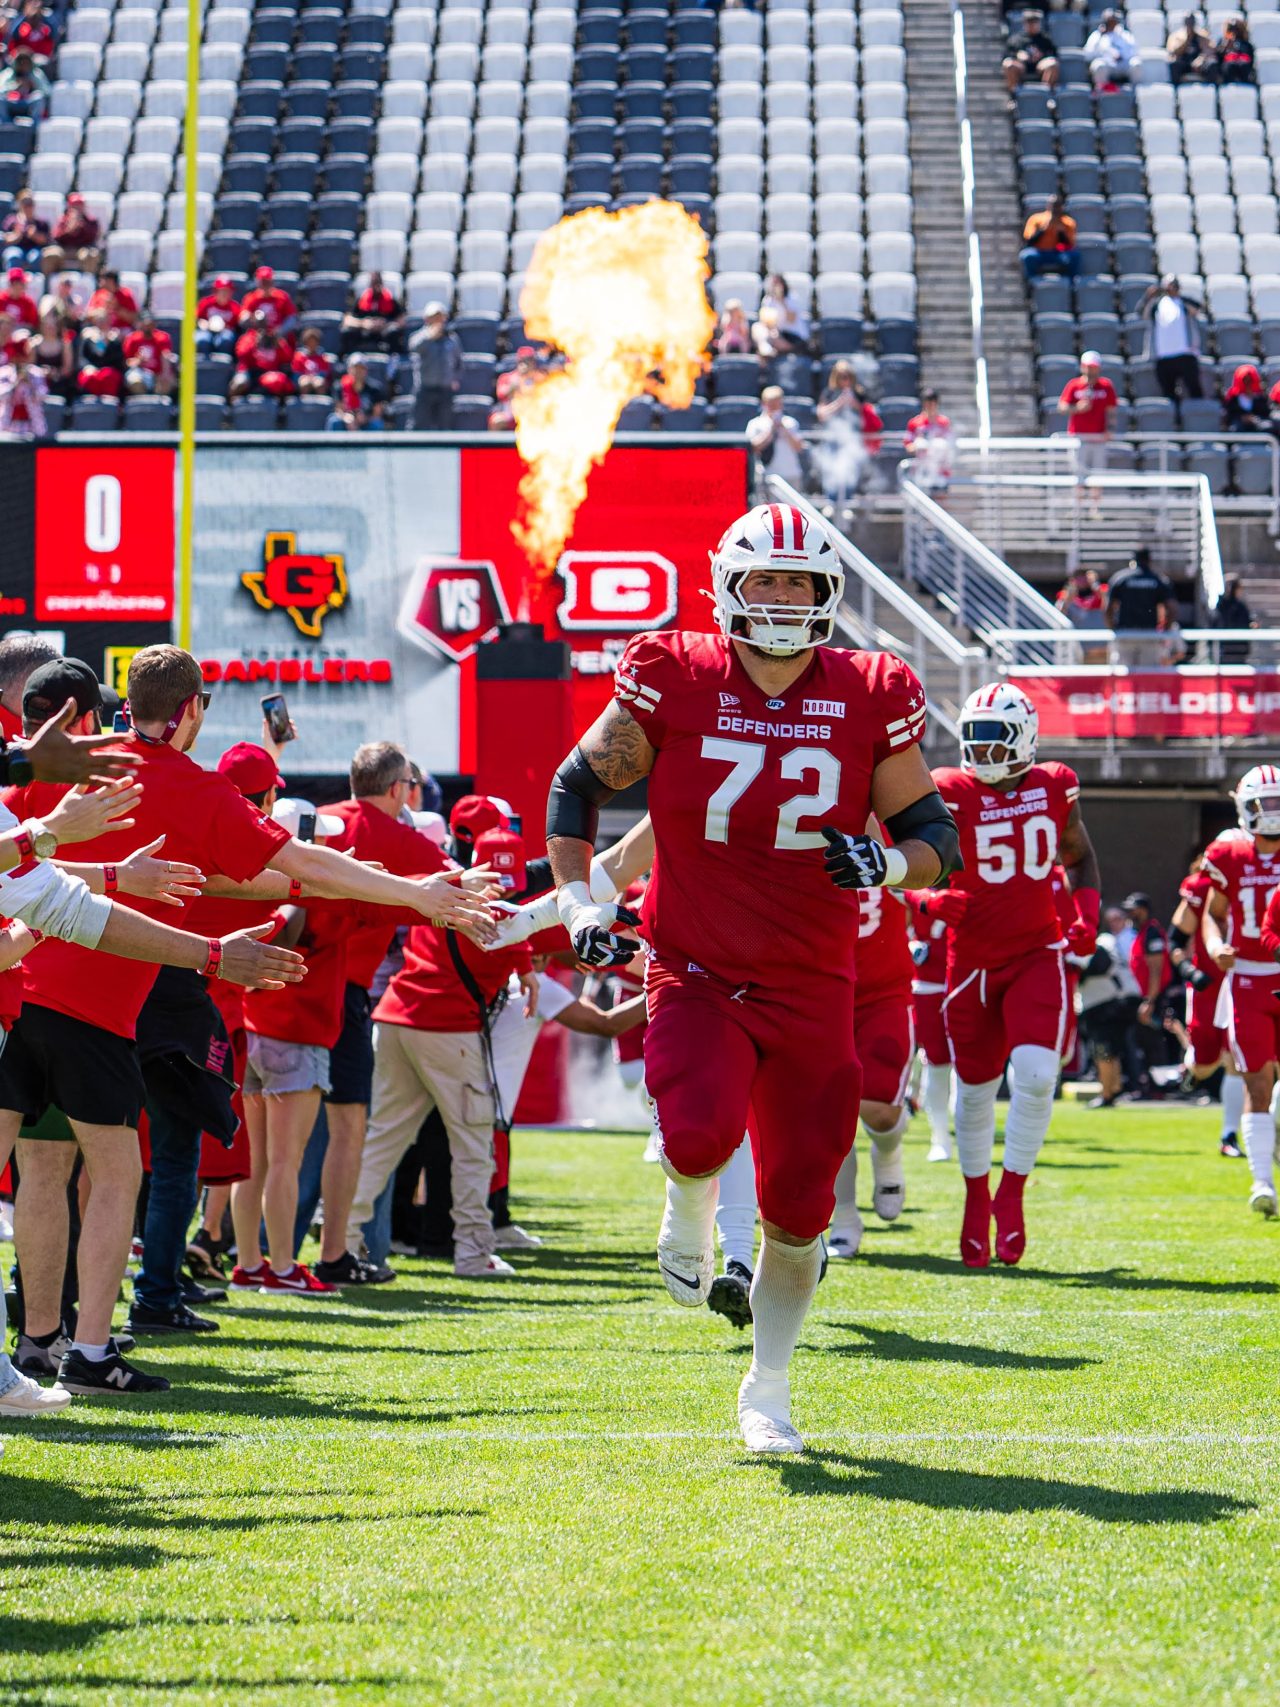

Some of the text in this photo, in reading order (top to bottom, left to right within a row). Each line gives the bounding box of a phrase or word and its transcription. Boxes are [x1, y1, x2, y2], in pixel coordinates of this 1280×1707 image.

[85, 474, 121, 552] 0
[264, 554, 335, 608] G
[438, 578, 480, 632] VS
[767, 700, 784, 708] UFL
[804, 700, 844, 716] NOBULL
[717, 716, 832, 740] DEFENDERS
[700, 736, 842, 851] 72
[980, 799, 1048, 822] DEFENDERS
[975, 815, 1057, 884] 50
[105, 1366, 133, 1388] N
